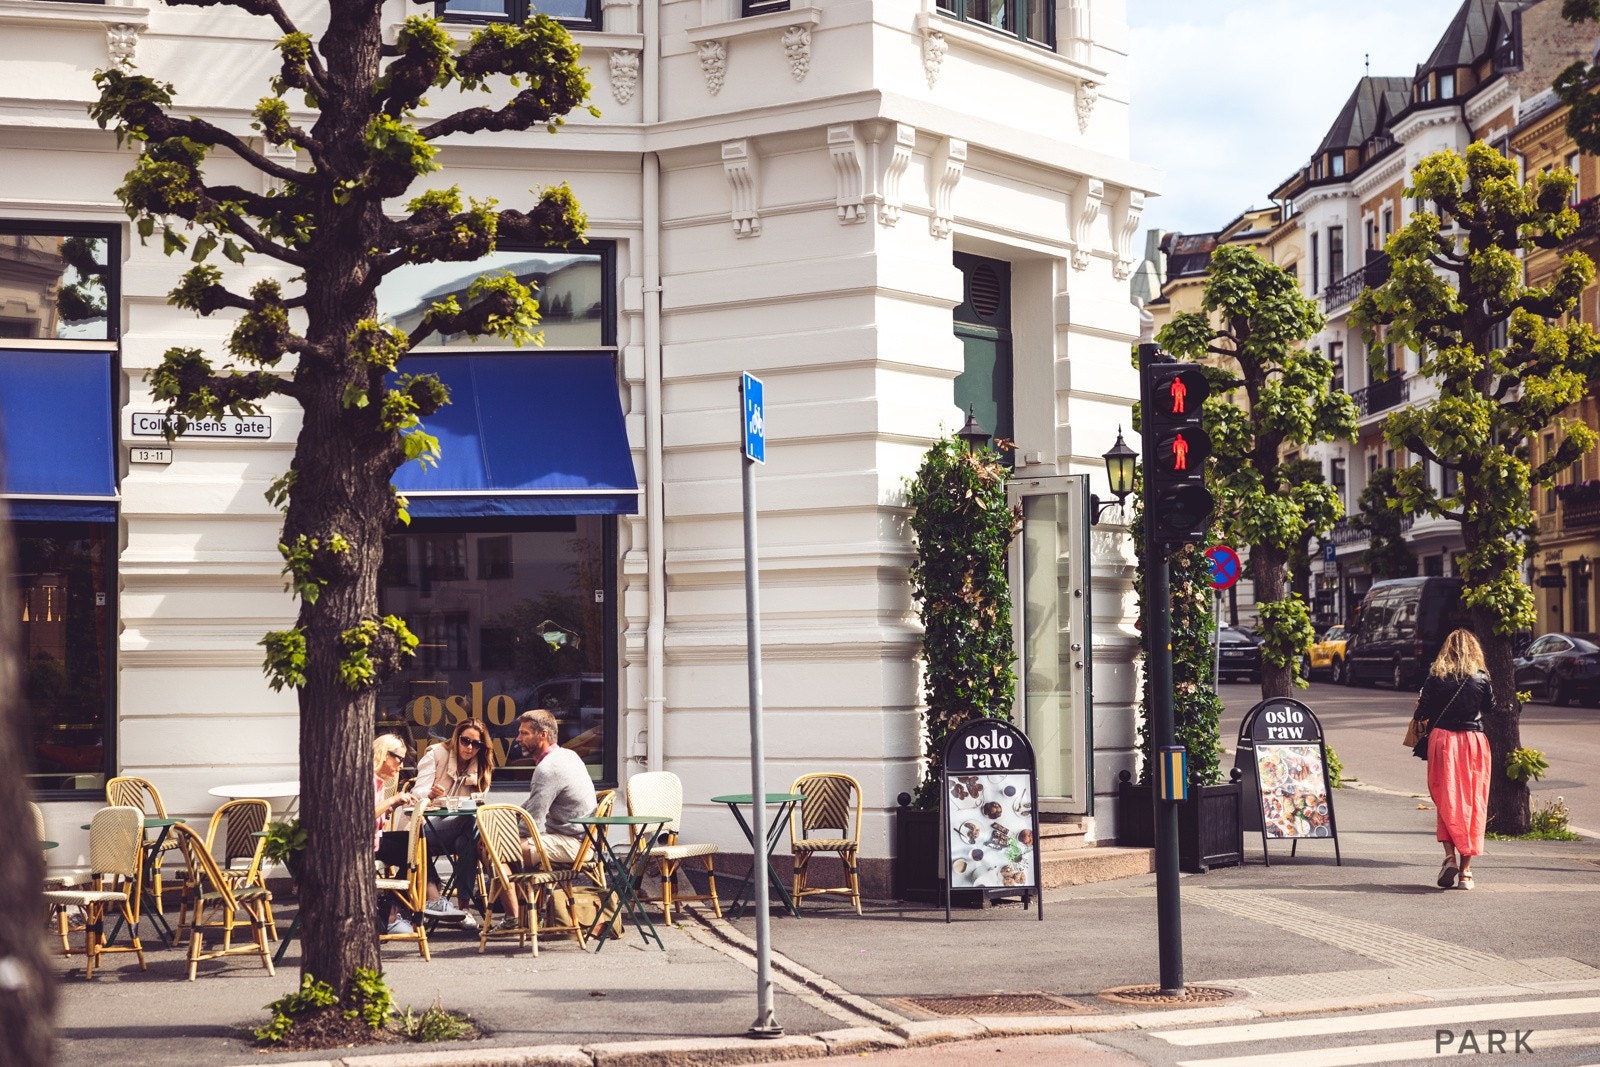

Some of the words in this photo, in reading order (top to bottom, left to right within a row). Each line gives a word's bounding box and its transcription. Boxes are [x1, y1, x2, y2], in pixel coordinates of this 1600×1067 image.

[140, 417, 227, 432] Colnsens
[234, 421, 265, 435] gate
[139, 451, 164, 461] 13-11
[1326, 546, 1333, 560] P
[412, 681, 516, 727] oslo
[1265, 706, 1304, 724] oslo
[965, 729, 1013, 750] oslo
[1267, 726, 1305, 739] raw
[965, 753, 1013, 769] raw
